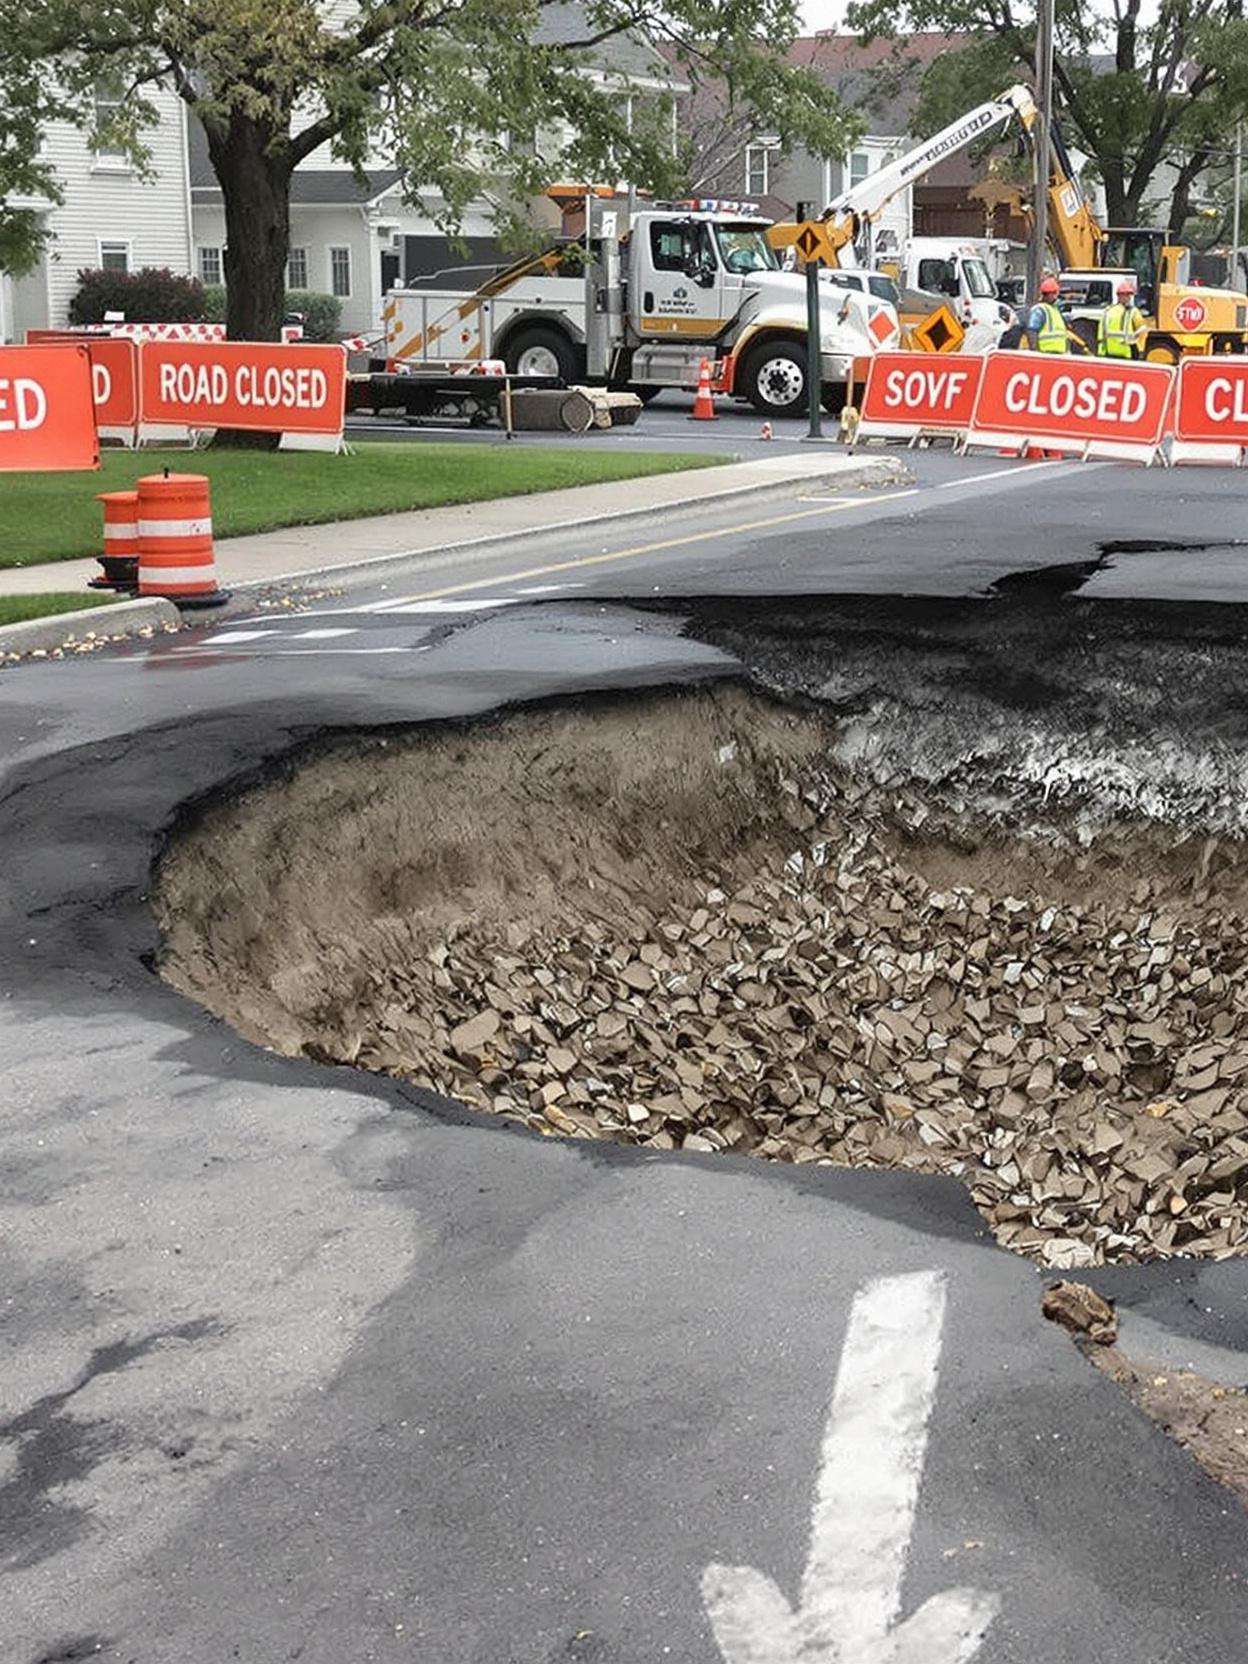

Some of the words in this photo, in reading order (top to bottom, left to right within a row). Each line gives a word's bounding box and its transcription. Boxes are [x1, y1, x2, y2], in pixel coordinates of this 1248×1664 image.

[160, 363, 228, 404] ROAD
[235, 366, 327, 408] CLOSED
[1005, 372, 1147, 422] CLOSED
